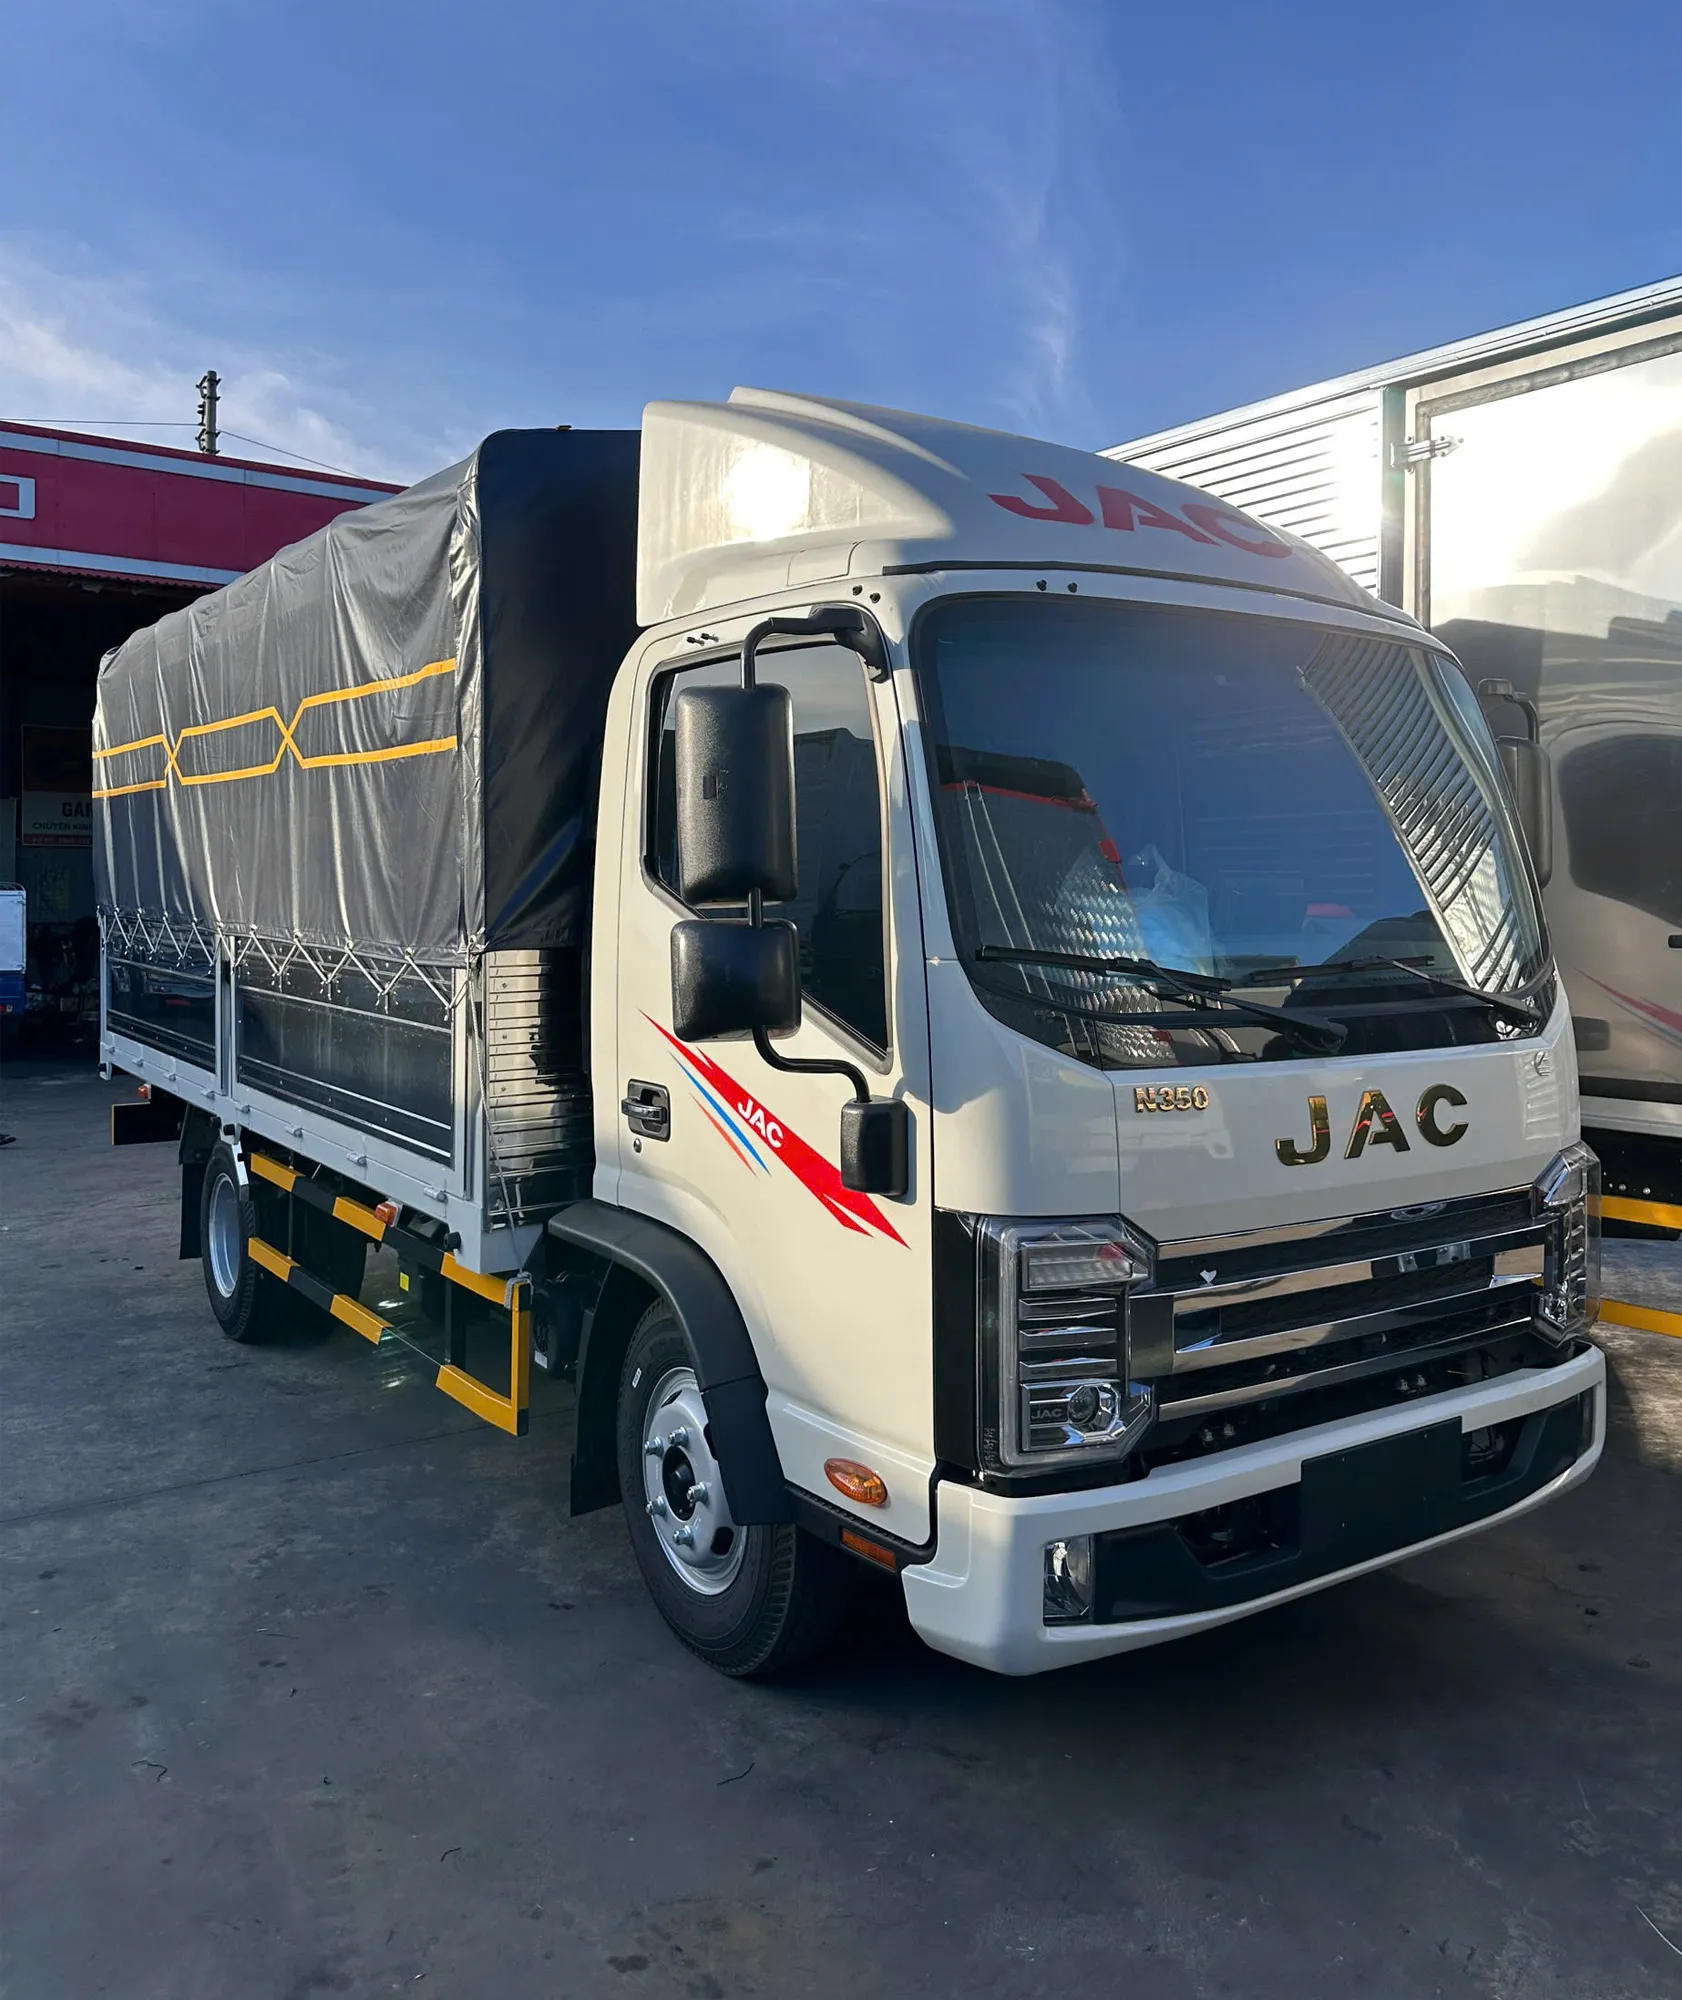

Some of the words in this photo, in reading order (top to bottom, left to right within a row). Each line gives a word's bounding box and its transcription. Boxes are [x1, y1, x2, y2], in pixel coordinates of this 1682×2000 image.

[987, 473, 1292, 558] JAC
[738, 1099, 783, 1148] JAC
[1134, 1085, 1209, 1113] N350
[1275, 1083, 1469, 1166] JAC
[1031, 1408, 1063, 1420] JAC
